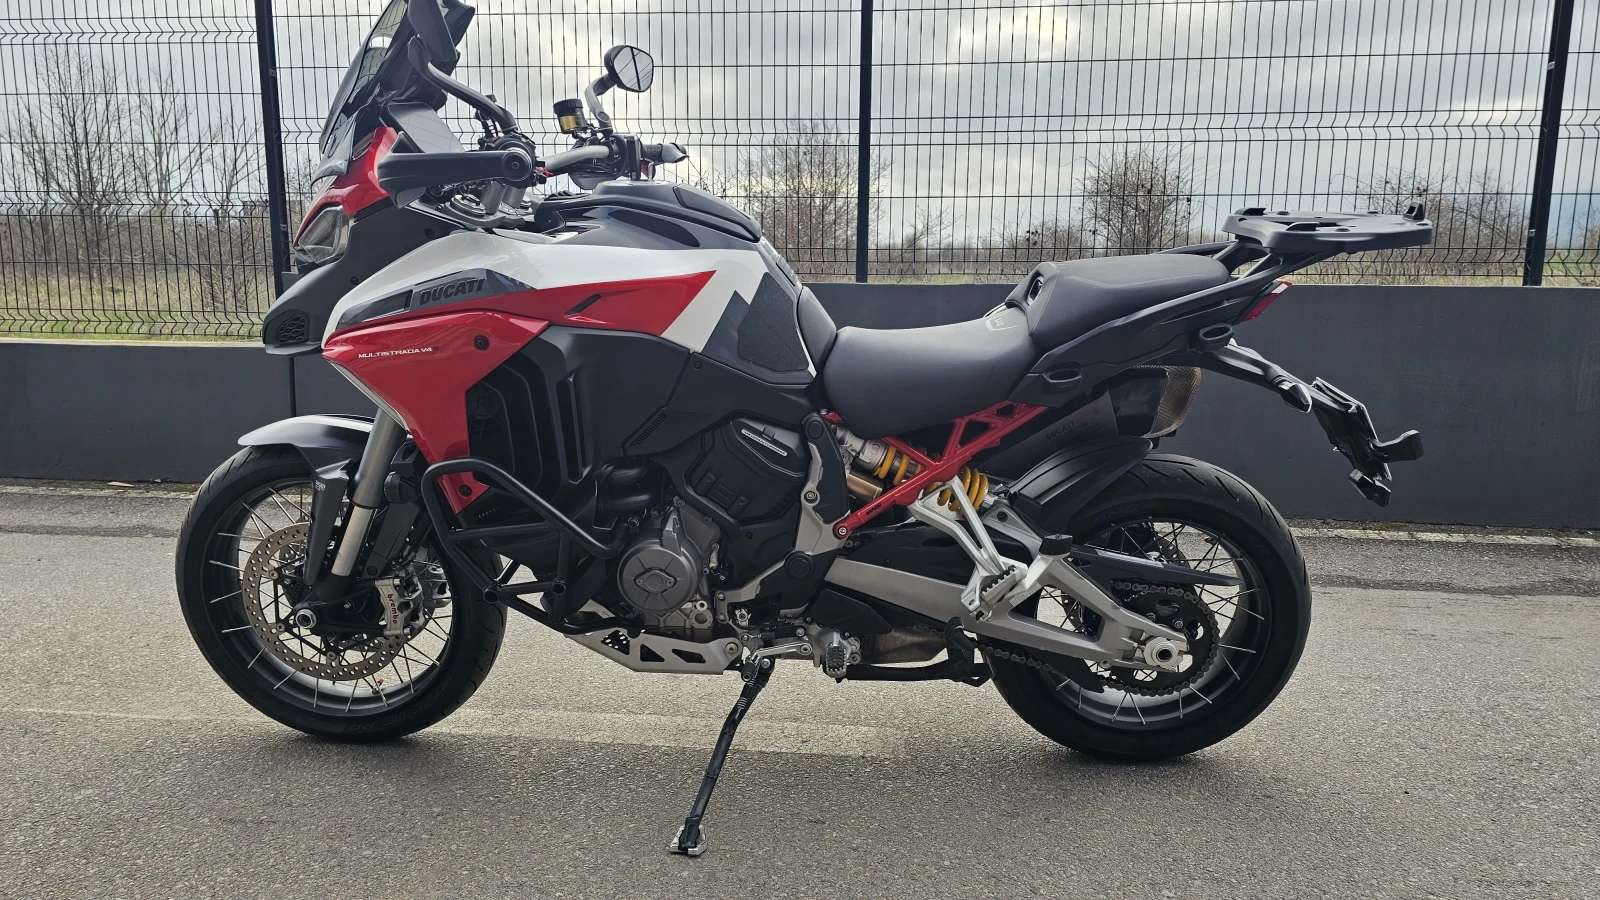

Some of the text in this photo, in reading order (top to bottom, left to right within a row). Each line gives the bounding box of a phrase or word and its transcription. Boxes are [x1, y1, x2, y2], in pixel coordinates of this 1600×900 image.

[420, 278, 486, 306] DUCATI
[358, 348, 420, 359] MULTISTRADA
[1045, 420, 1075, 441] DUCATI
[387, 593, 399, 624] brembo
